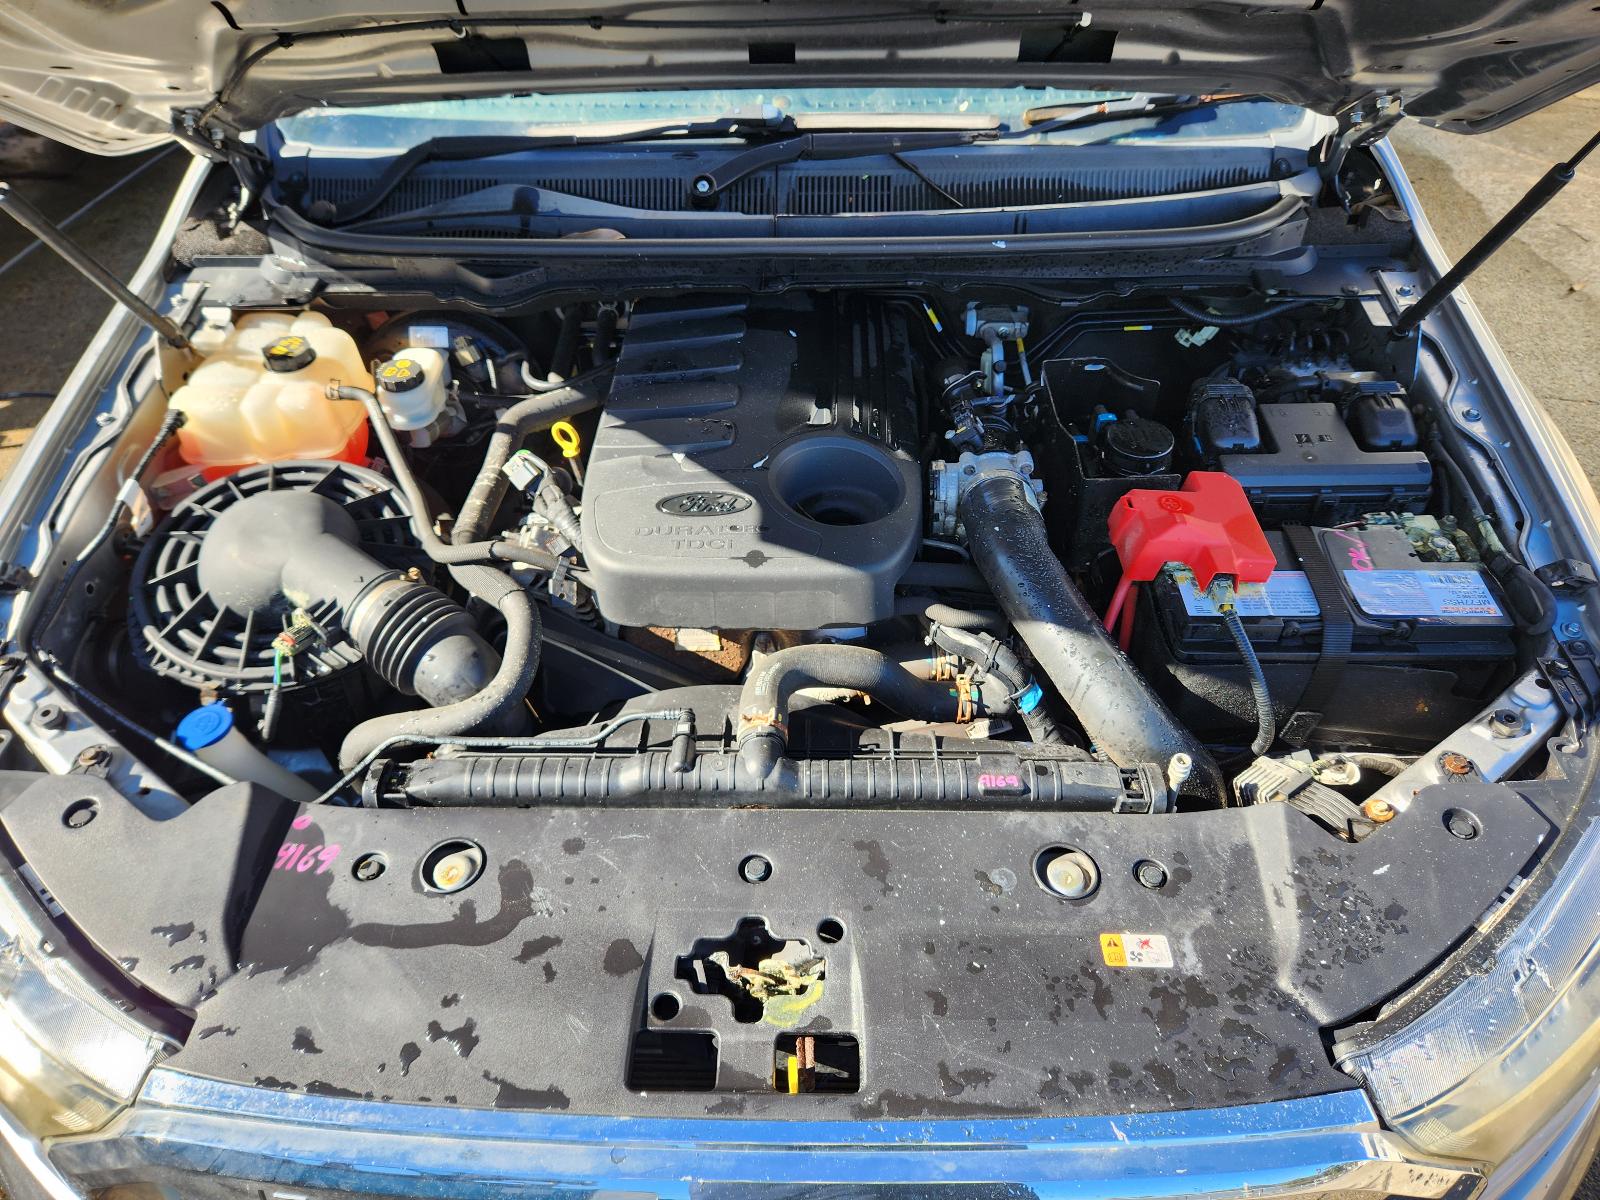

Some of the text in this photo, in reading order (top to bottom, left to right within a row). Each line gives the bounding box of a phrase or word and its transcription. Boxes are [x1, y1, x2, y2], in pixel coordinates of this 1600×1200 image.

[679, 495, 738, 514] Ford
[635, 524, 769, 537] DURATOR
[672, 538, 734, 550] TDCi
